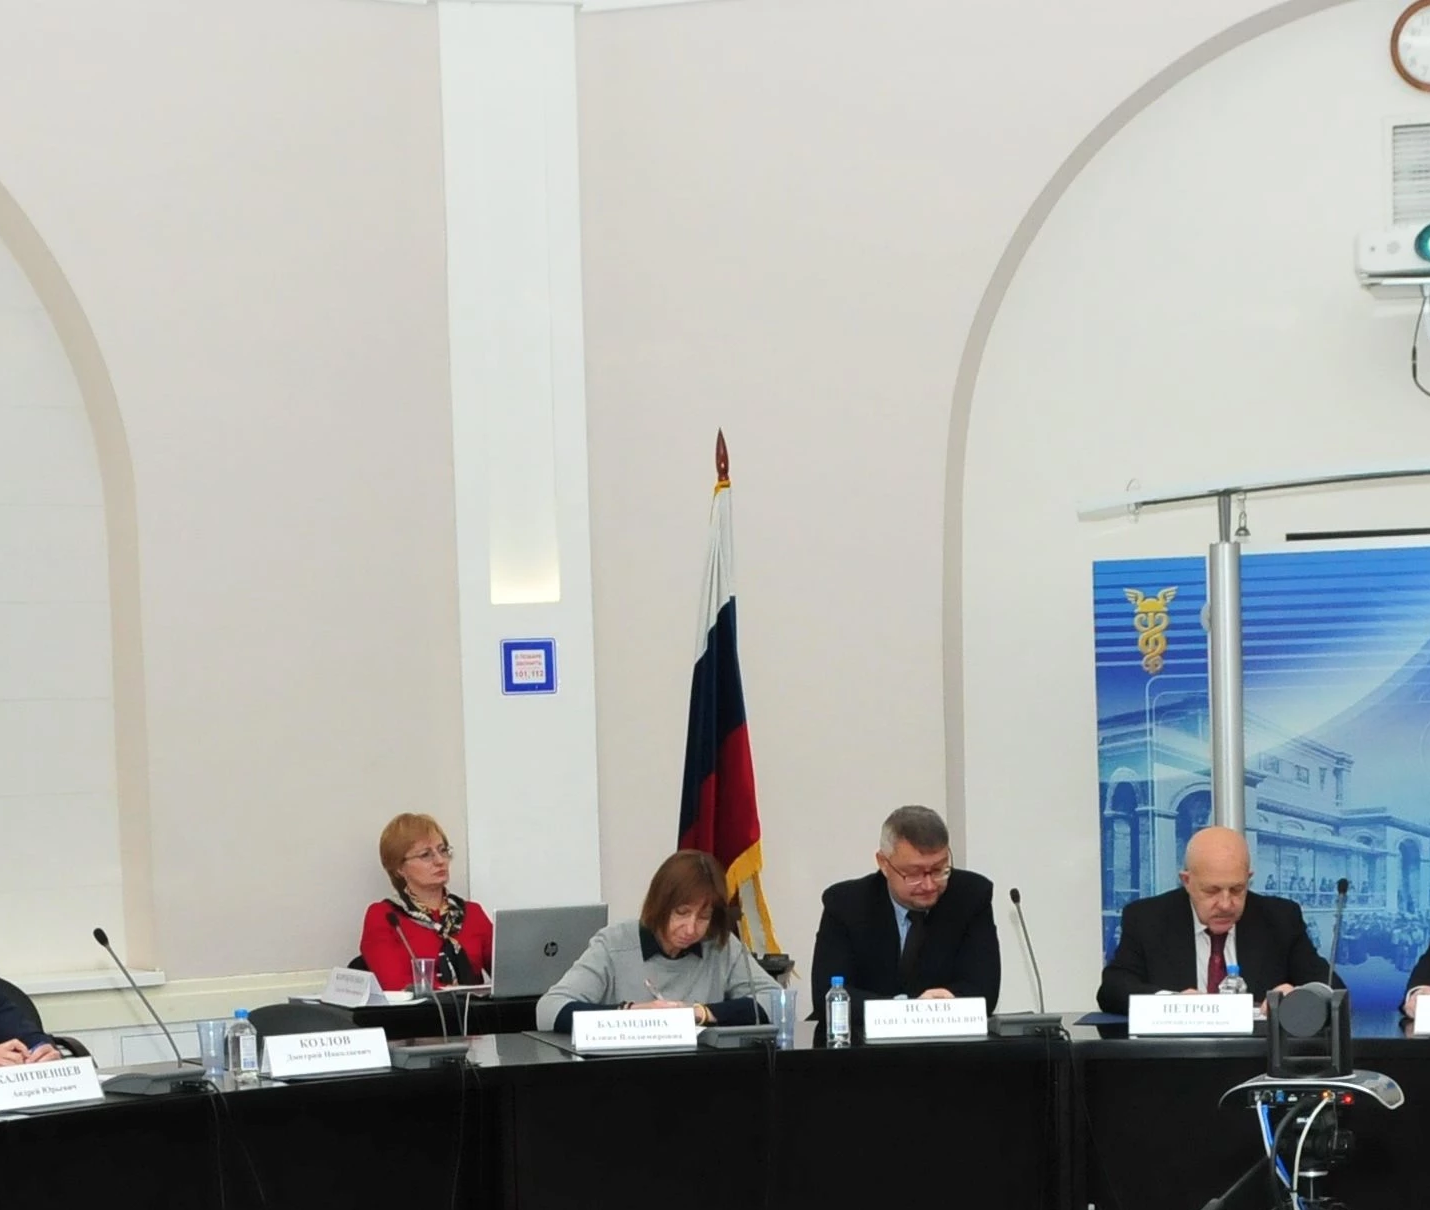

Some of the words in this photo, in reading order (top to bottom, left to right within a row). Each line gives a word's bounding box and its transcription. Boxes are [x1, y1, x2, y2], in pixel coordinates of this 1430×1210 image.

[906, 1003, 952, 1013] ИСАЕВ
[1163, 1004, 1220, 1014] ПЕТРОВ
[299, 1034, 351, 1049] КОЗЛОВ
